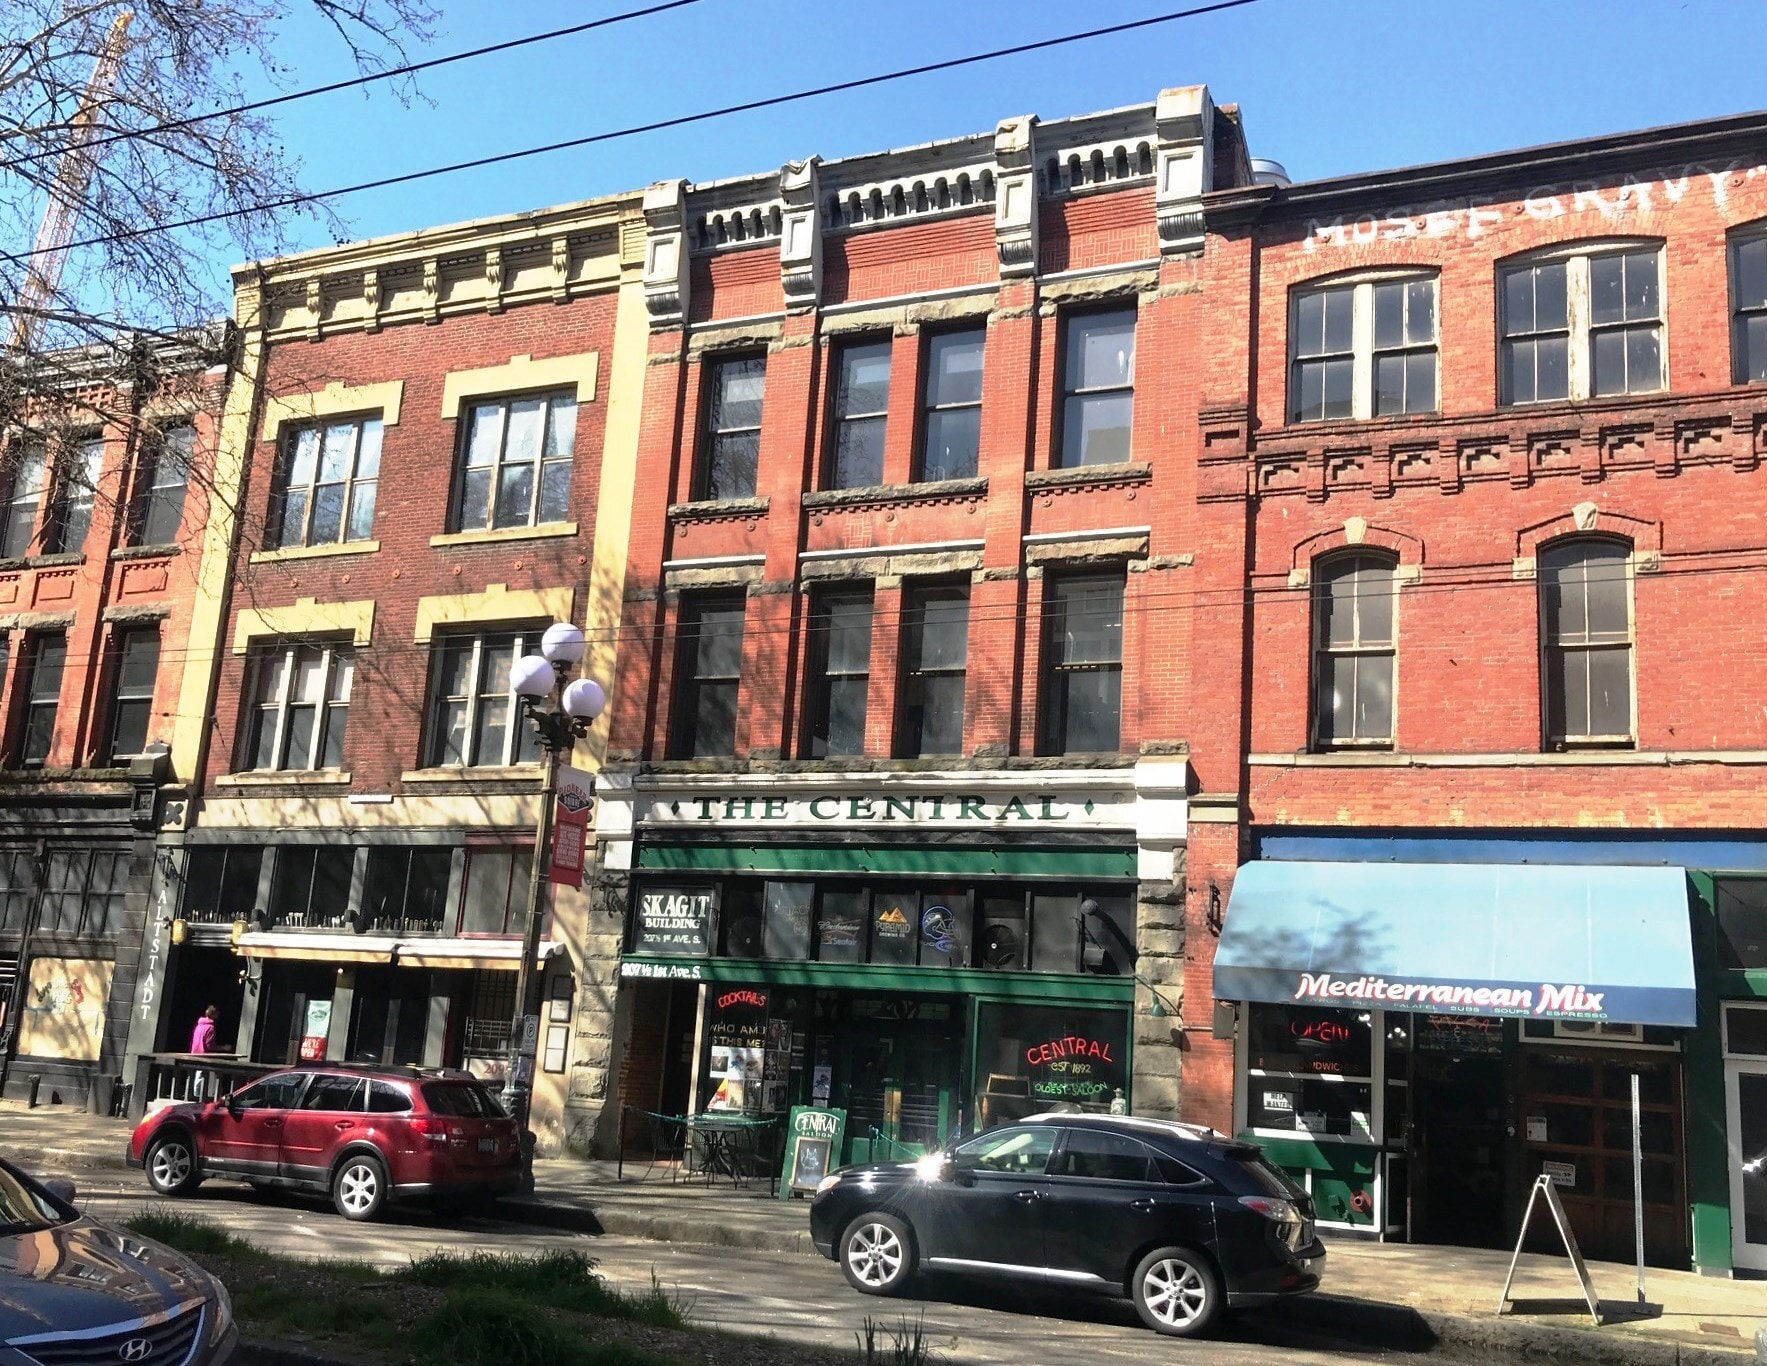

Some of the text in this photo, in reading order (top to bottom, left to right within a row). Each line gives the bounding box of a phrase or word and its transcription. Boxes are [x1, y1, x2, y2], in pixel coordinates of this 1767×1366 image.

[692, 795, 1071, 820] THE CENTRAL
[642, 895, 710, 917] SKAGIT
[645, 918, 701, 929] BUILDING
[673, 934, 691, 944] AVE.
[693, 935, 701, 944] S.
[140, 889, 168, 1020] ALTSTADT
[669, 965, 691, 979] Ave.
[692, 965, 702, 979] S.
[718, 990, 766, 1008] COCKTAILS
[1295, 973, 1605, 1015] Mediterranean Mix
[1394, 1003, 1438, 1011] FALAFEL
[1450, 1005, 1480, 1013] SUBS
[1494, 1007, 1530, 1016] SOUPS
[1546, 1010, 1608, 1019] ESPRESSO
[740, 1025, 758, 1035] AM
[1291, 1021, 1350, 1042] OPEN
[719, 1036, 742, 1047] THIS
[1027, 1037, 1112, 1064] CENTRAL
[1072, 1063, 1091, 1074] 1892
[1072, 1081, 1109, 1096] SALOON
[795, 1112, 838, 1134] CENTRAL
[801, 1130, 832, 1138] SALOON
